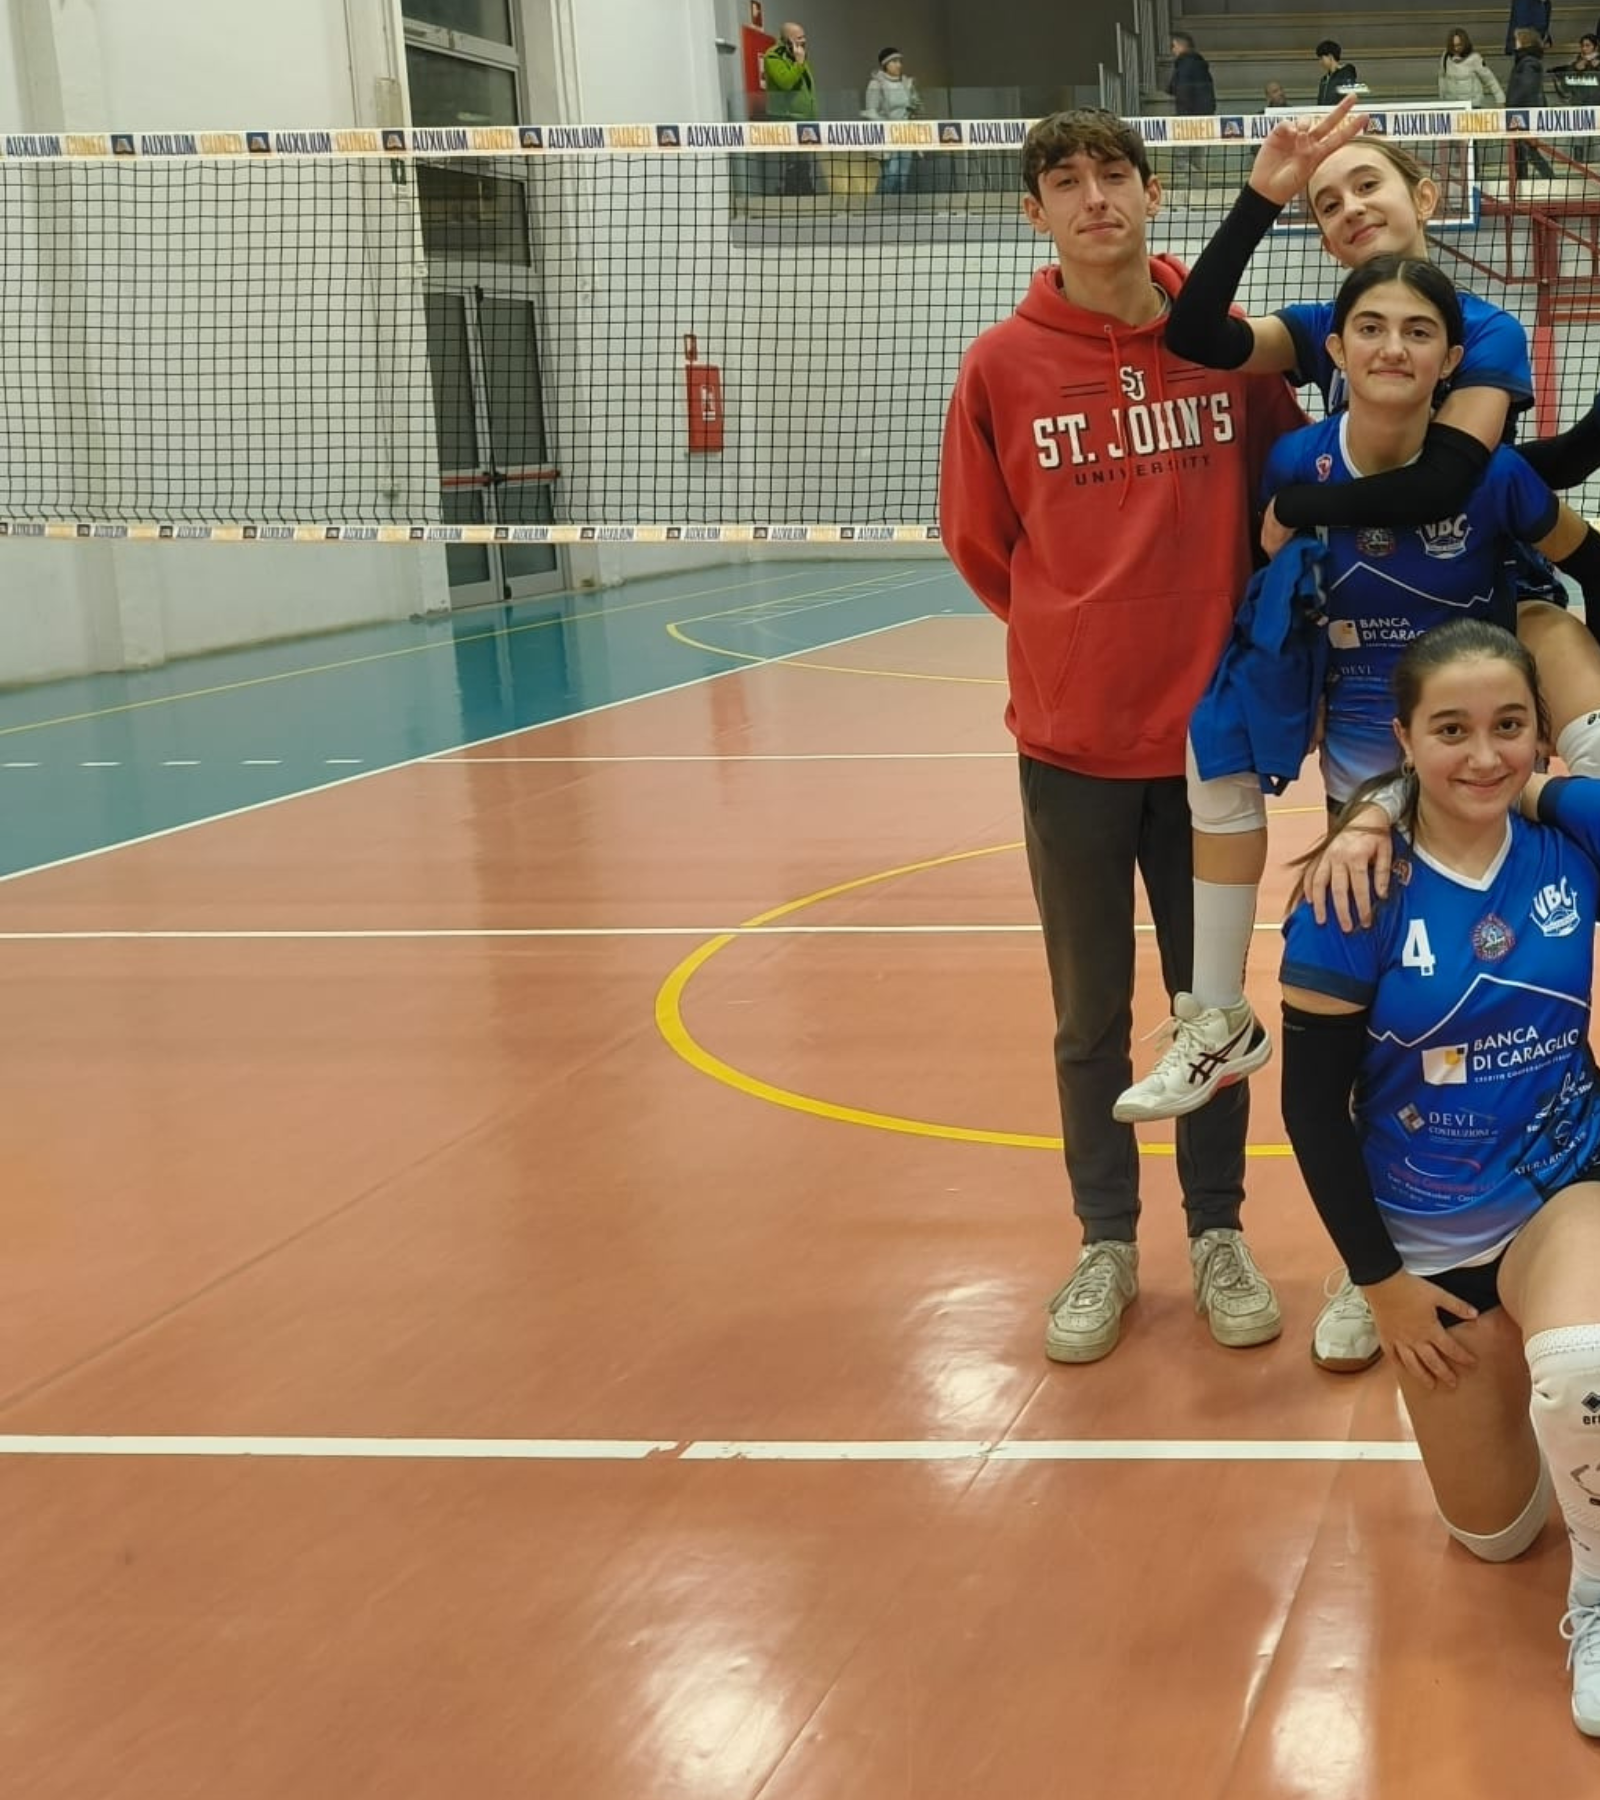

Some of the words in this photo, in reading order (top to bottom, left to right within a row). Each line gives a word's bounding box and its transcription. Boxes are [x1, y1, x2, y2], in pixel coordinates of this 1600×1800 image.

[1392, 114, 1451, 136] AUXILIUM
[1537, 110, 1595, 131] AUXILIUM
[276, 132, 331, 154] AUXILIUM
[412, 130, 468, 151] AUXILIUM
[548, 127, 604, 149] AUXILIUM
[687, 125, 744, 147] AUXILIUM
[828, 124, 885, 145] AUXILIUM
[969, 122, 1026, 143] AUXILIUM
[6, 135, 61, 156] AUXILIUM
[141, 134, 197, 155] AUXILIUM
[1033, 412, 1096, 468] ST.
[1107, 392, 1233, 459] JOHN'S
[1360, 617, 1411, 628] BANCA
[1363, 629, 1377, 641] DI
[1532, 875, 1571, 920] VBC
[1402, 918, 1436, 977] 4
[1473, 1025, 1540, 1052] BANCA
[1473, 1055, 1492, 1071] DI
[1496, 1028, 1580, 1068] CARAGLIO
[1429, 1111, 1474, 1127] DEVI
